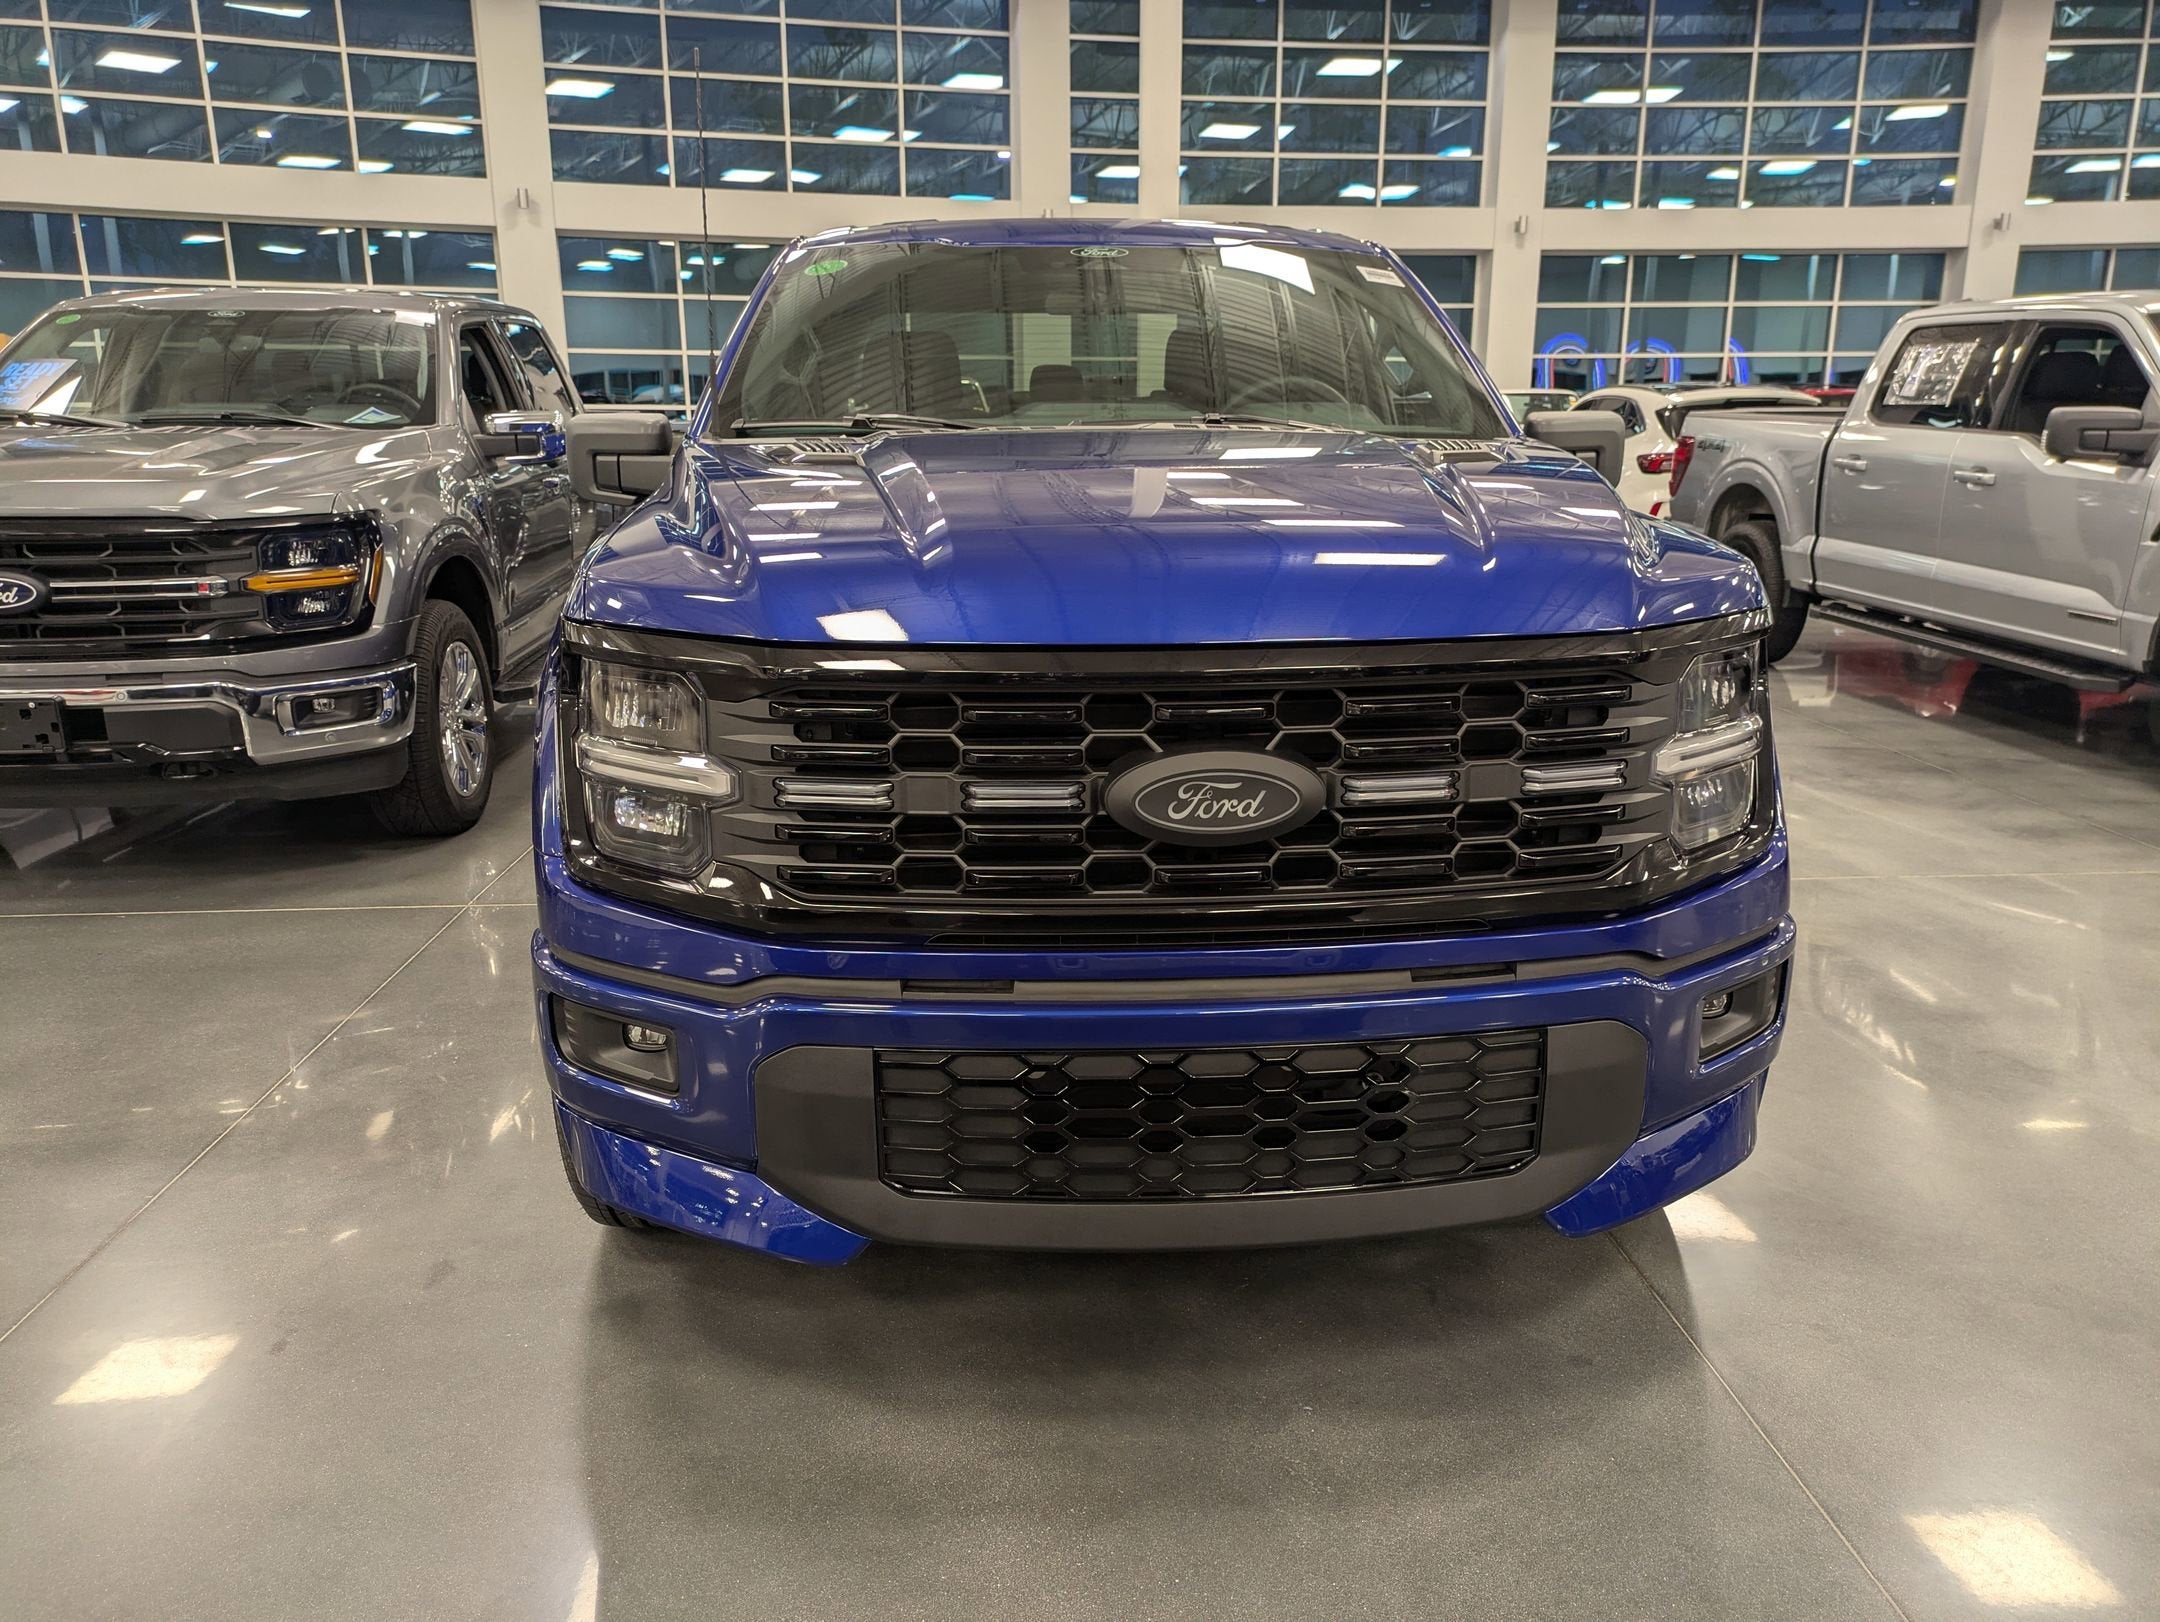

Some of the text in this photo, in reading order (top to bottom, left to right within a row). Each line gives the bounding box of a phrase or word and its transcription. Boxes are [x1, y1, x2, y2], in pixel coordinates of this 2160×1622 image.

[1080, 248, 1119, 257] Ford
[0, 362, 66, 377] READY
[1167, 781, 1267, 820] Ford
